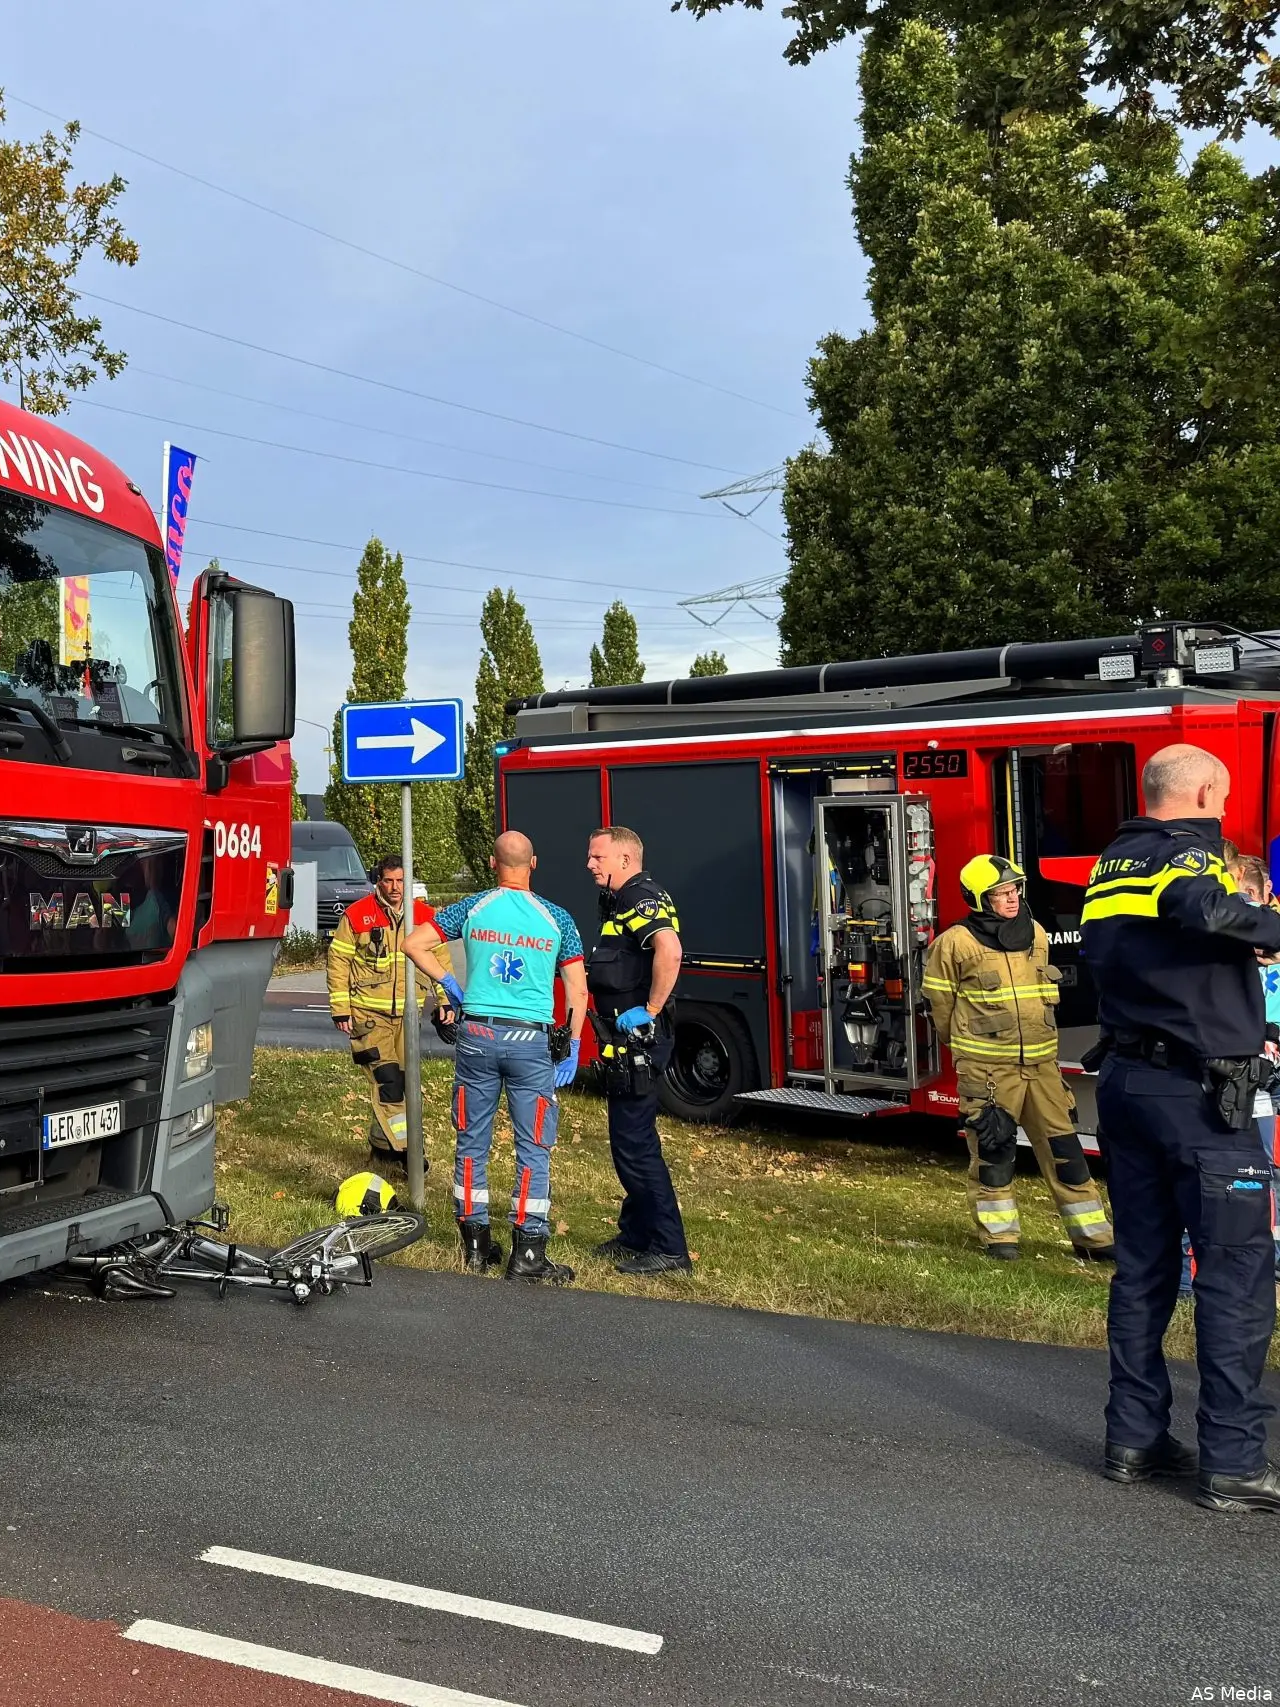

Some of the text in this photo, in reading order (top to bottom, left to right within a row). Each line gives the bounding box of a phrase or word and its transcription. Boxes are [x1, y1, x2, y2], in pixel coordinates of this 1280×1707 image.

[906, 754, 960, 774] 2550
[203, 819, 262, 859] 0684
[29, 892, 131, 930] MAN
[362, 914, 377, 925] BV
[470, 928, 554, 953] AMBULANCE
[1045, 930, 1082, 945] RAND
[50, 1106, 119, 1142] LER RT 437
